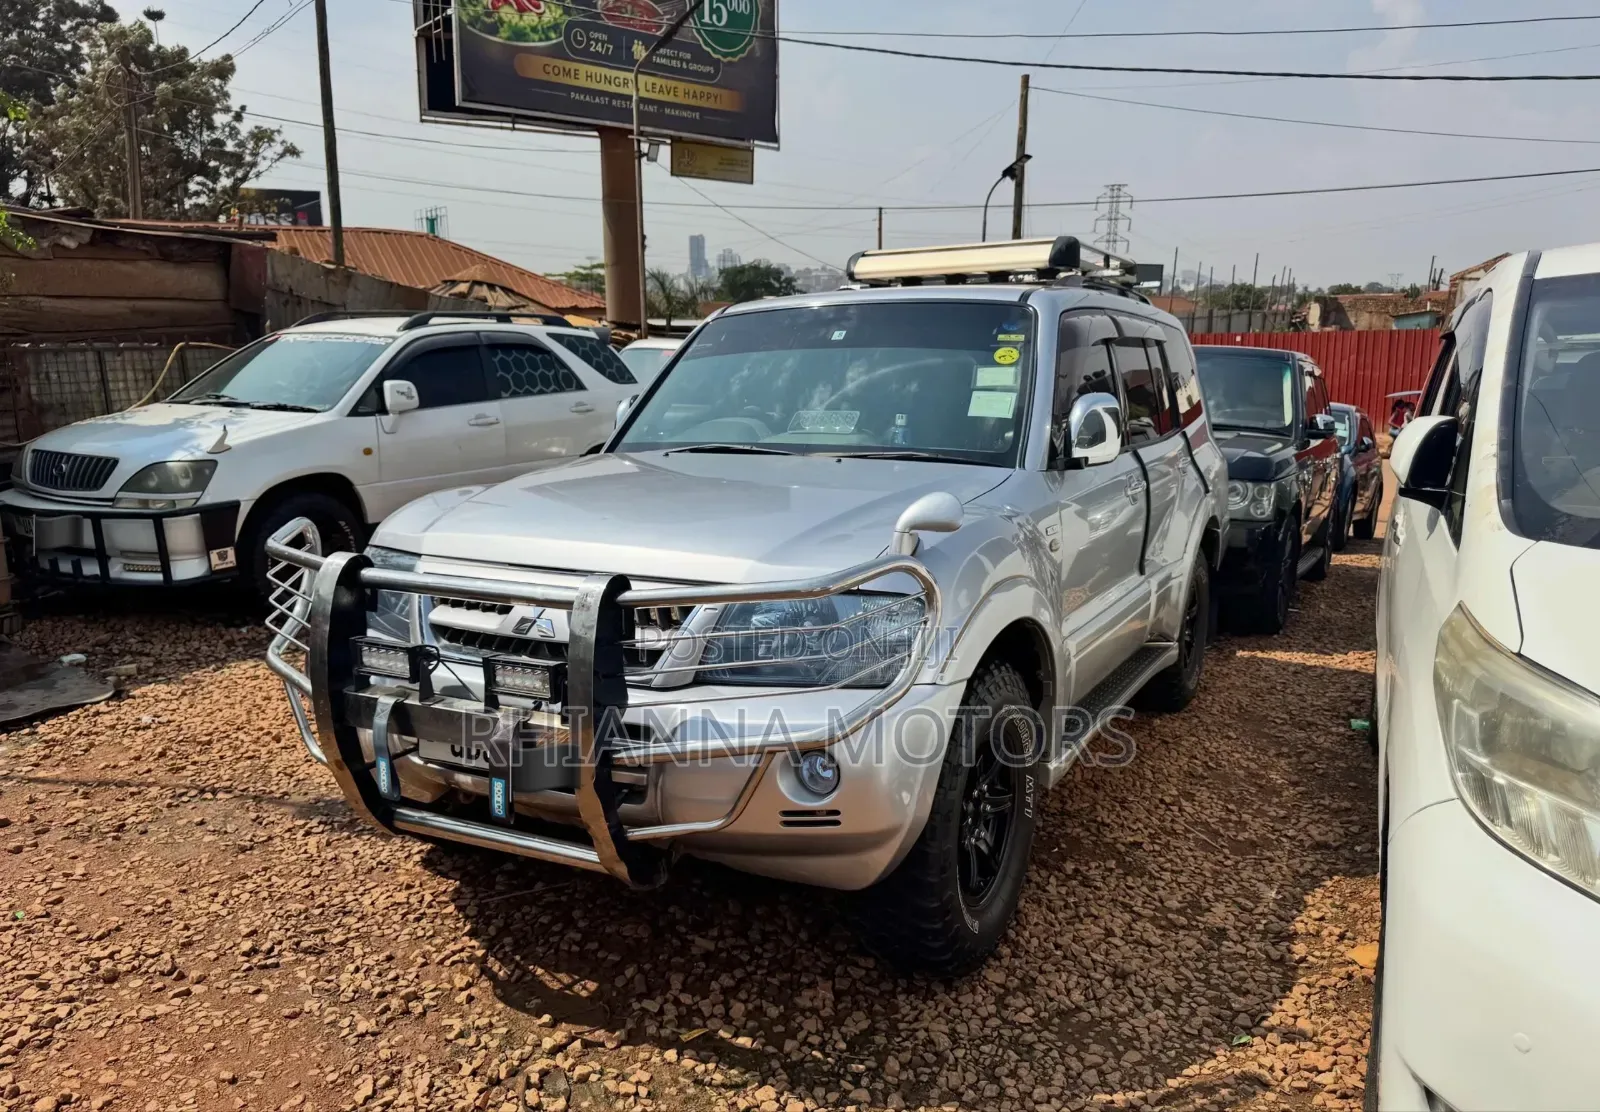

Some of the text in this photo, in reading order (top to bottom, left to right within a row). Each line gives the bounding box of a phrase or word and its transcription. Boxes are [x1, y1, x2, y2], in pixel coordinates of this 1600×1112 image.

[589, 31, 608, 41] OPEN
[589, 41, 613, 55] 24/7
[655, 47, 692, 60] RFECT FOR
[652, 56, 681, 69] FAMILIES
[688, 63, 714, 74] GROUPS
[542, 63, 580, 80] COME
[644, 80, 680, 97] LEAVE
[683, 88, 723, 104] HAPPY!
[570, 91, 609, 105] PAKALAST
[611, 99, 658, 113] RESTARANT
[664, 107, 700, 120] MAKINDYE
